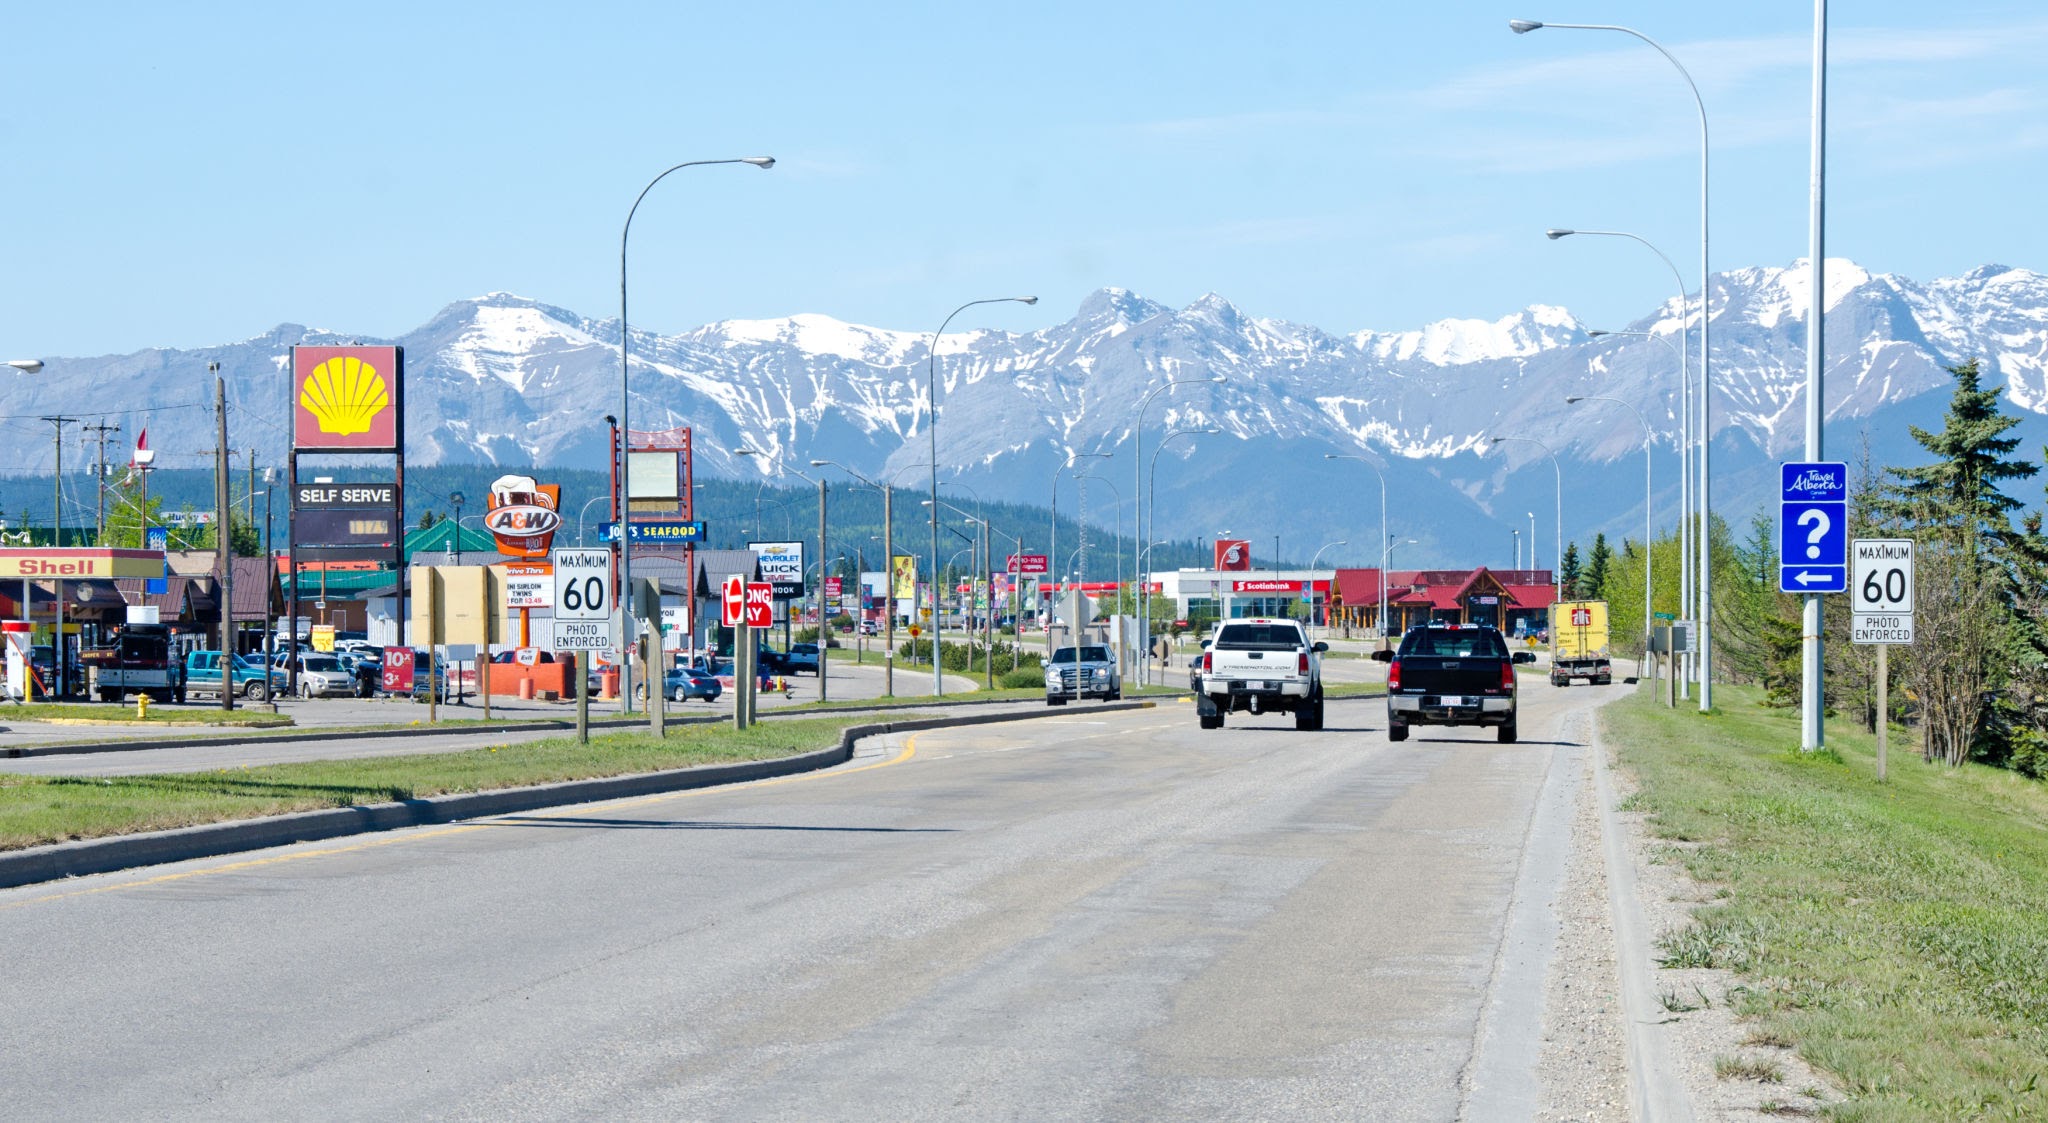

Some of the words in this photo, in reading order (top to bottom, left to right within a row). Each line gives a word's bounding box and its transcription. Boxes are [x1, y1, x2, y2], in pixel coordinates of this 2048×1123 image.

[1806, 470, 1835, 482] Travel
[1786, 474, 1843, 492] Alberta
[300, 489, 337, 503] SELF
[341, 489, 391, 502] SERVE
[495, 512, 550, 530] A&W
[643, 526, 696, 536] SEAFOOD
[1859, 548, 1909, 560] MAXIMUM
[18, 559, 94, 575] Shell
[560, 555, 607, 568] MAXIMUM
[1247, 582, 1290, 590] Scotiabank
[1863, 568, 1906, 603] 60
[564, 576, 604, 610] 60
[747, 607, 762, 621] AY
[1867, 618, 1899, 628] PHOTO
[567, 625, 597, 635] PHOTO
[1856, 630, 1910, 640] ENFORCED
[557, 637, 607, 647] ENFORCED
